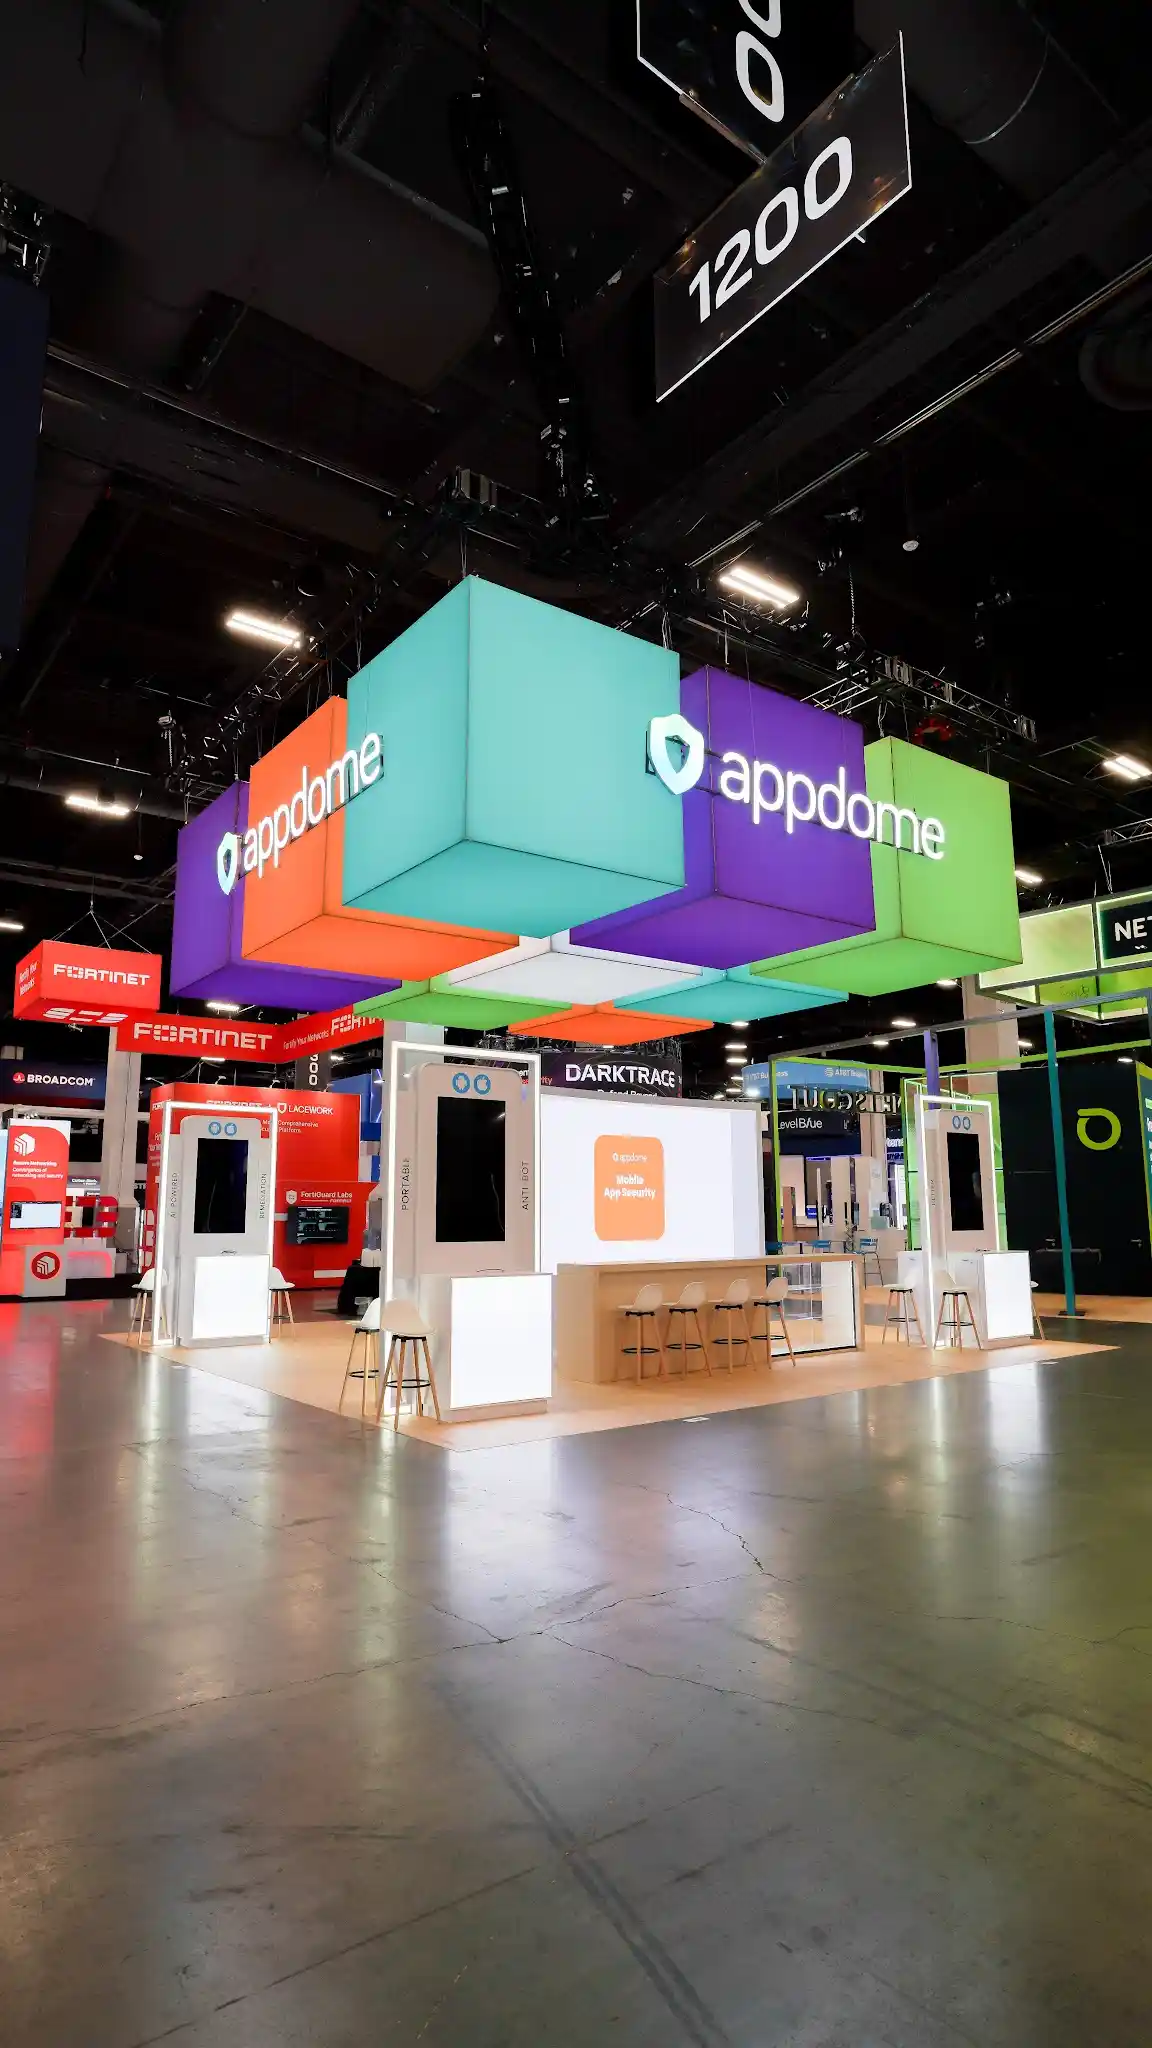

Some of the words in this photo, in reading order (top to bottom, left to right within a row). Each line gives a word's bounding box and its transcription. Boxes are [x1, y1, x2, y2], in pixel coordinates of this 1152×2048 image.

[688, 136, 853, 324] 1200
[243, 732, 381, 879] appdome
[720, 751, 946, 860] appdome
[53, 963, 151, 986] FORTINET
[133, 1022, 273, 1051] FORTINET
[27, 1074, 94, 1087] BROADCOM
[565, 1064, 675, 1088] DARKTRACE
[288, 1105, 334, 1115] LACEWORK
[170, 1172, 178, 1207] POWERED
[259, 1173, 267, 1219] REMEDIATION
[604, 1187, 621, 1201] App
